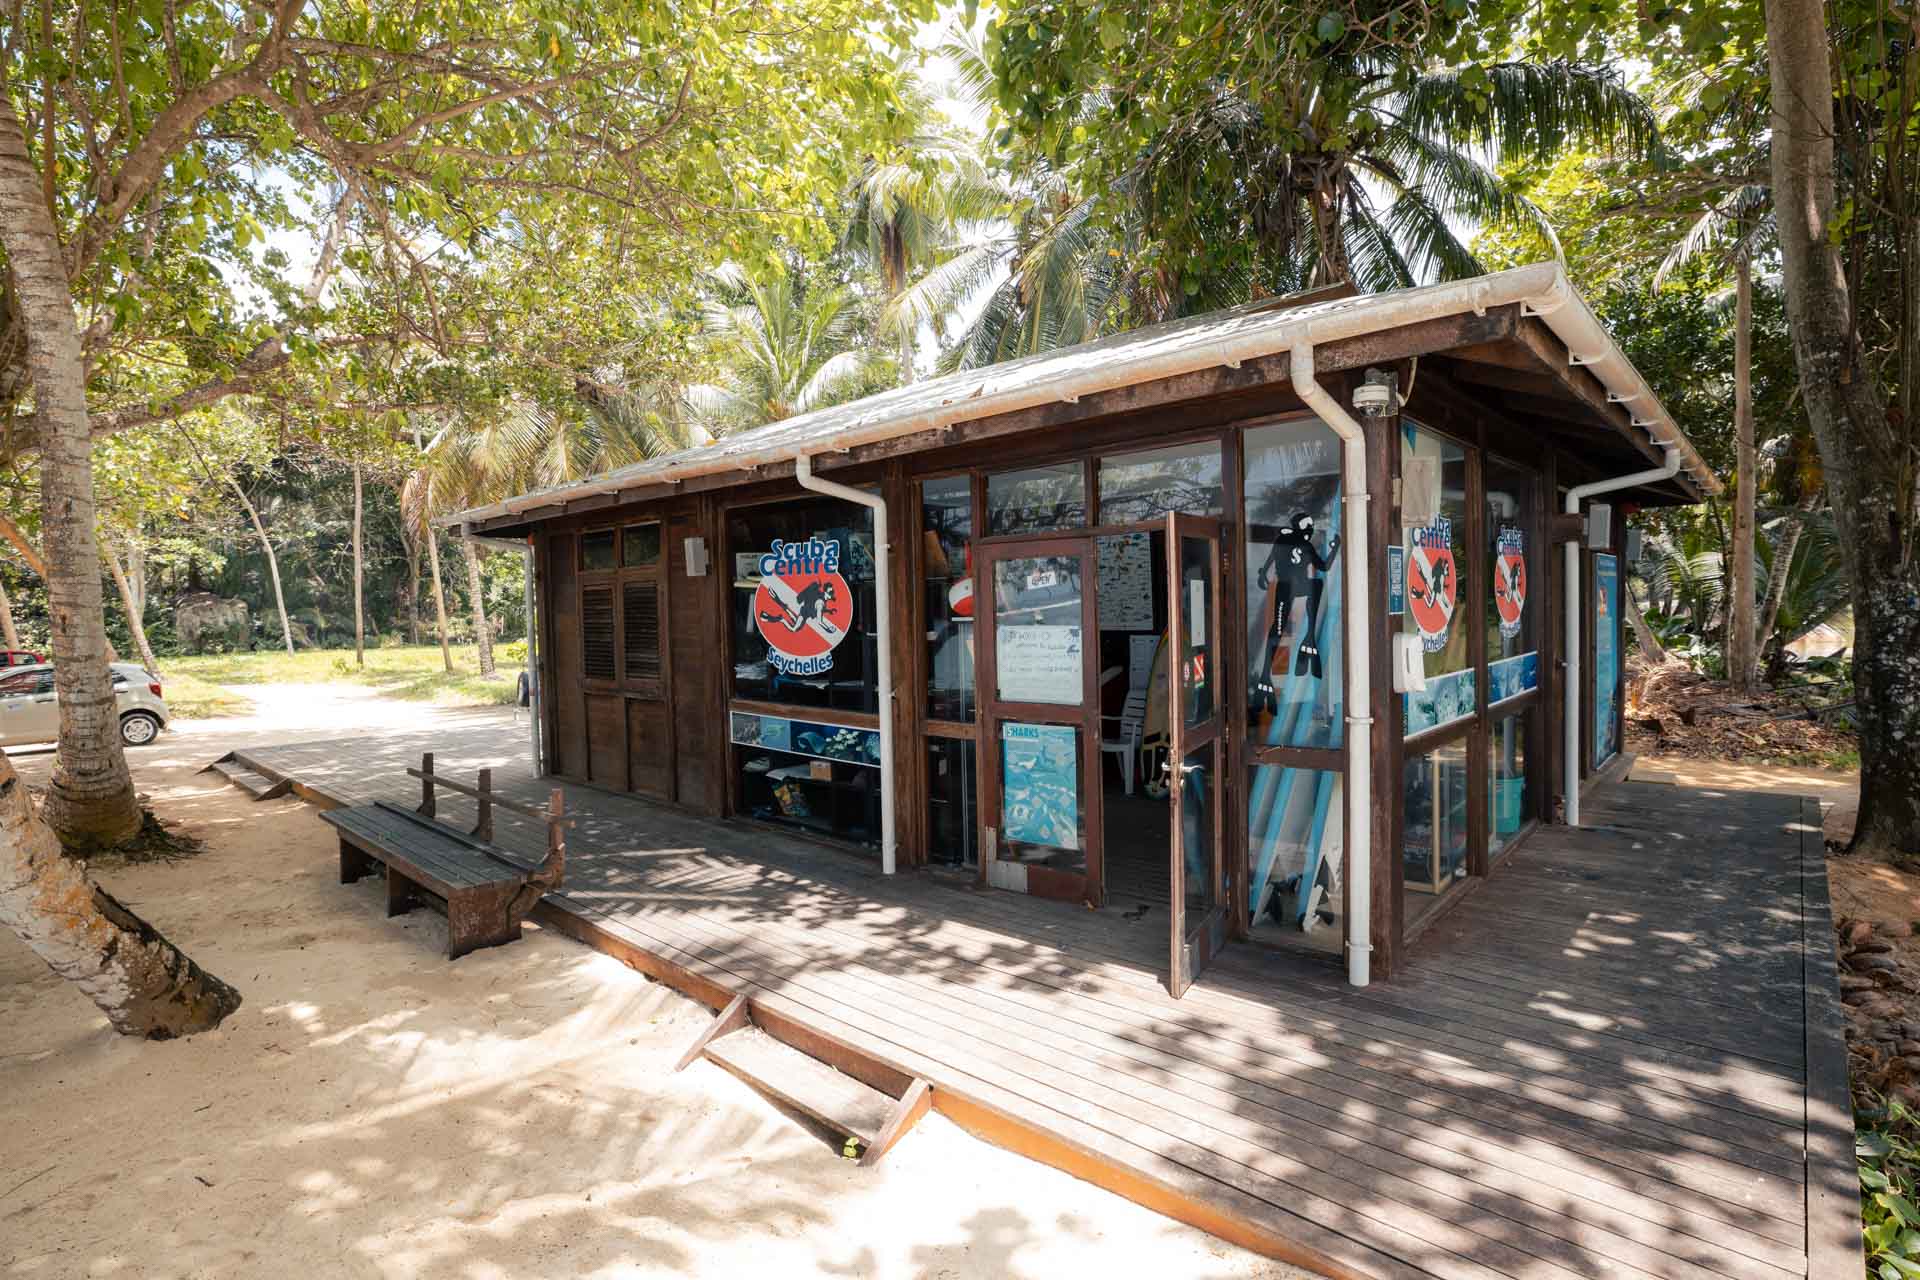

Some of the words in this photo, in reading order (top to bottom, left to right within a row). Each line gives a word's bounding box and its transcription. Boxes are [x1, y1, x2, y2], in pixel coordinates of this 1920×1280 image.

[771, 537, 839, 559] Scuba
[1411, 527, 1451, 549] Centre
[759, 554, 839, 577] Centre
[767, 647, 833, 674] Seychelles
[1007, 726, 1039, 738] SHARKS
